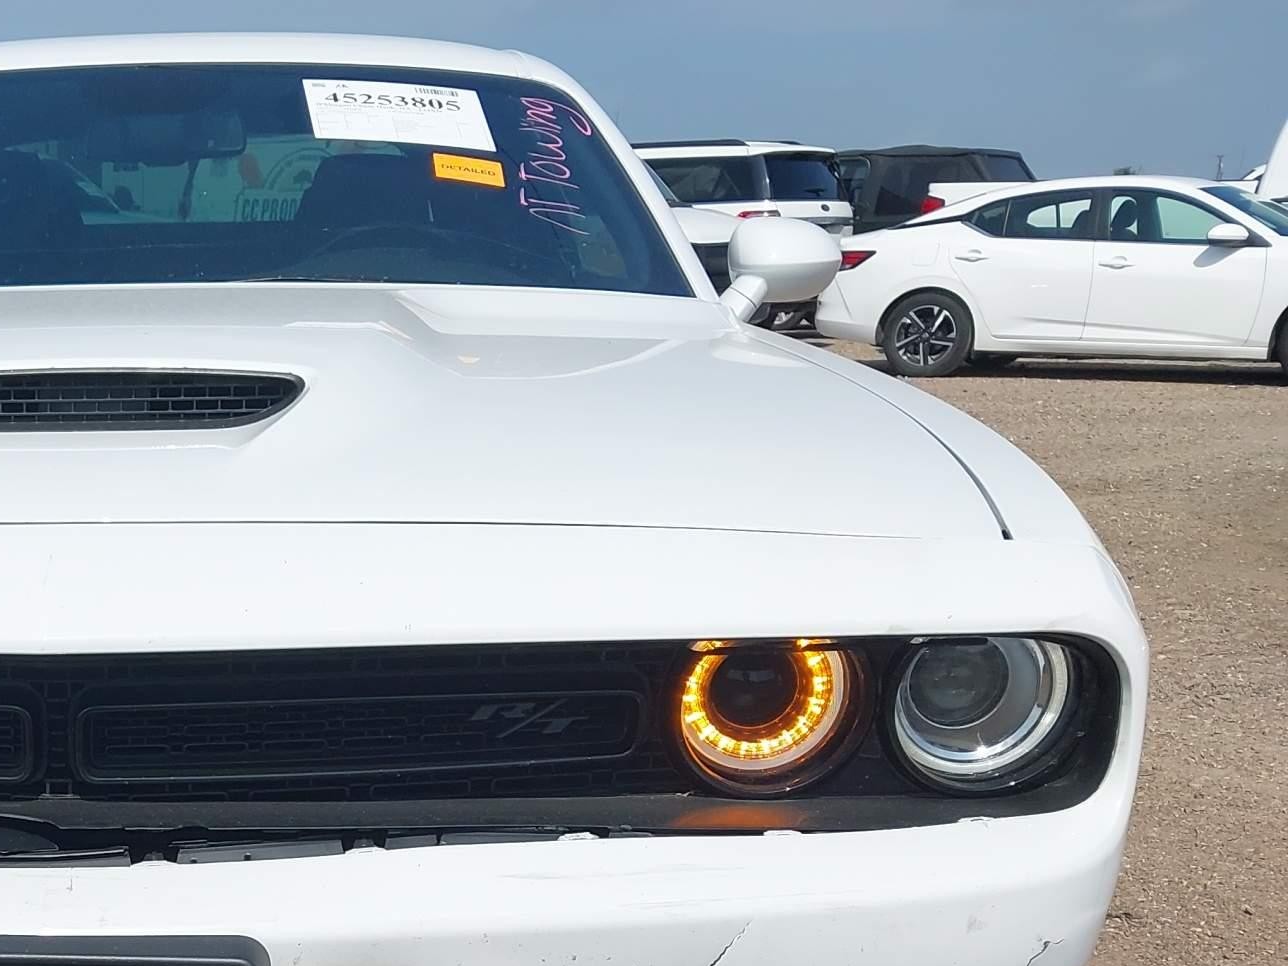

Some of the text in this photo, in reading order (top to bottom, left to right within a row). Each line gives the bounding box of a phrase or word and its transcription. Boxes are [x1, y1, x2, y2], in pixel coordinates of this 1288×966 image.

[324, 92, 461, 112] 45253805
[518, 97, 592, 189] Towing
[441, 163, 496, 177] DETAILED
[470, 698, 590, 738] R/T
